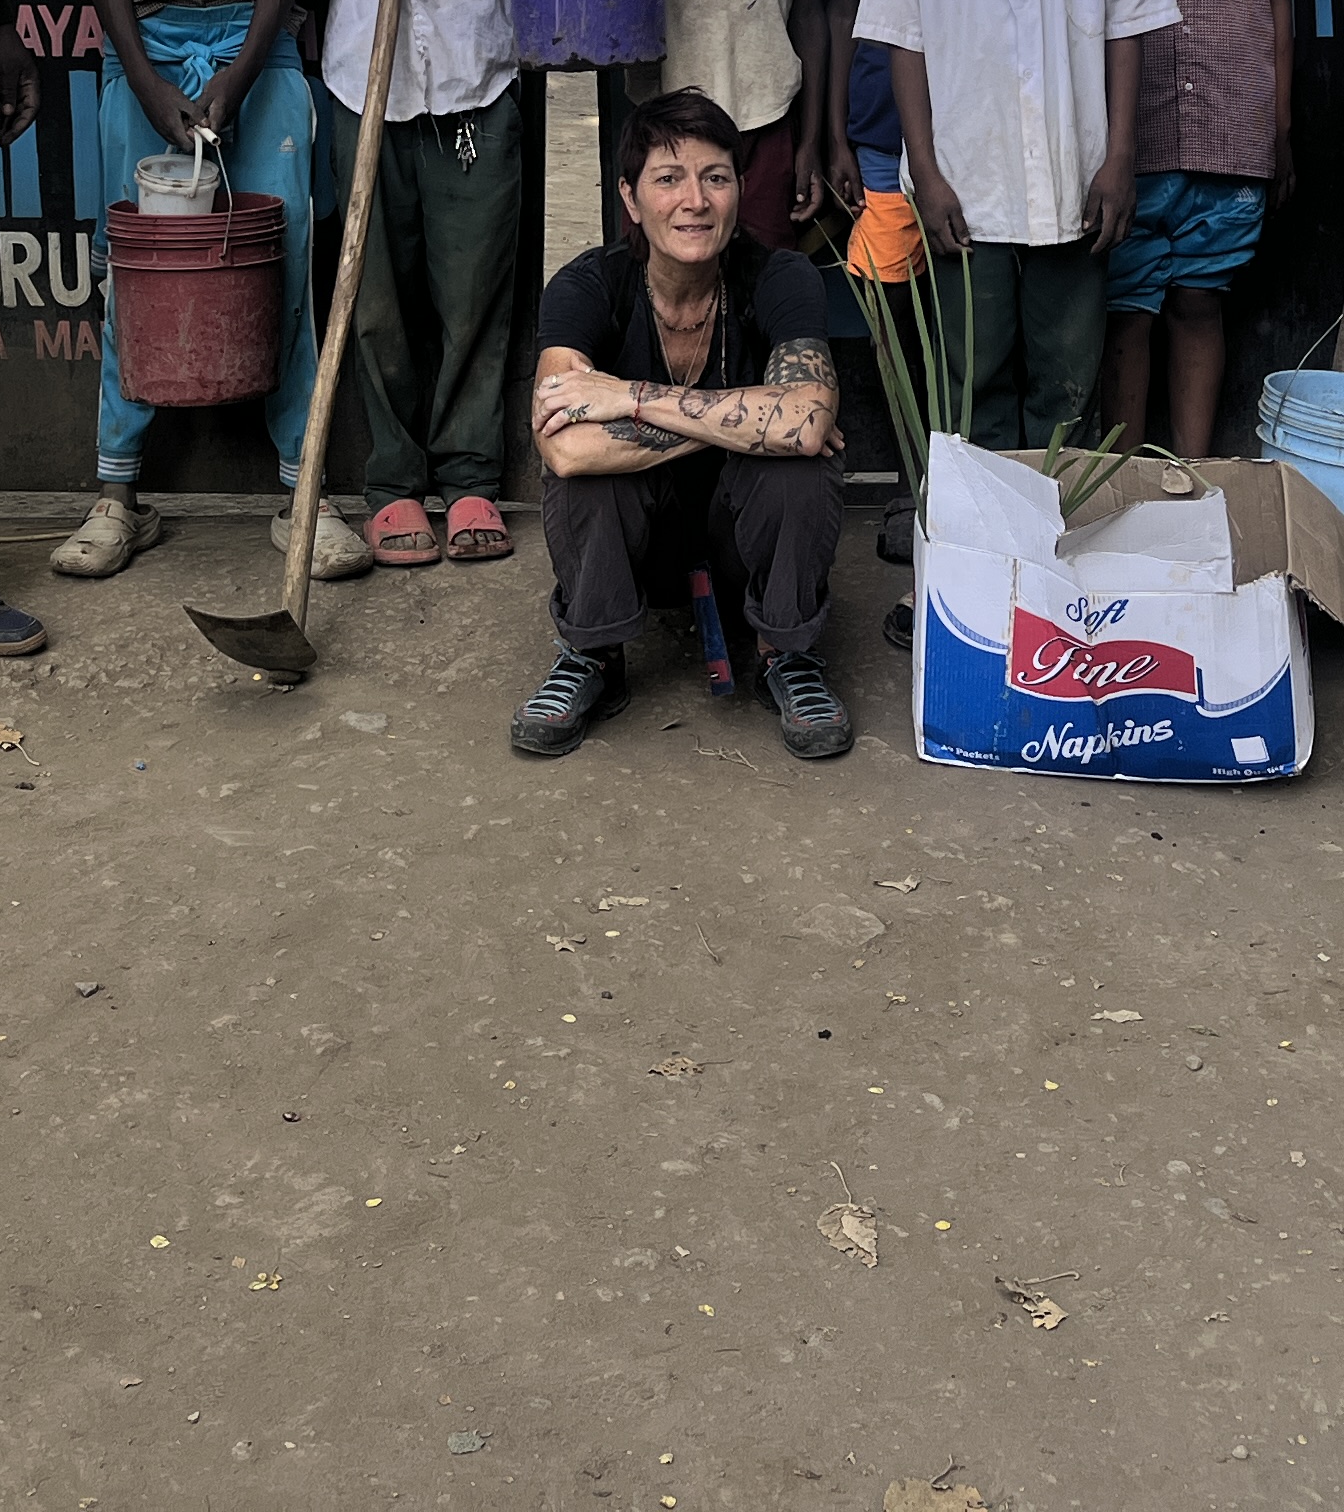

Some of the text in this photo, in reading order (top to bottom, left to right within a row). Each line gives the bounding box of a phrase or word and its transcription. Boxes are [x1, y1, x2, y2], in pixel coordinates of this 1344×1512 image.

[1065, 596, 1130, 636] Soft
[1016, 636, 1161, 689] Fine
[1020, 718, 1174, 765] Napkins
